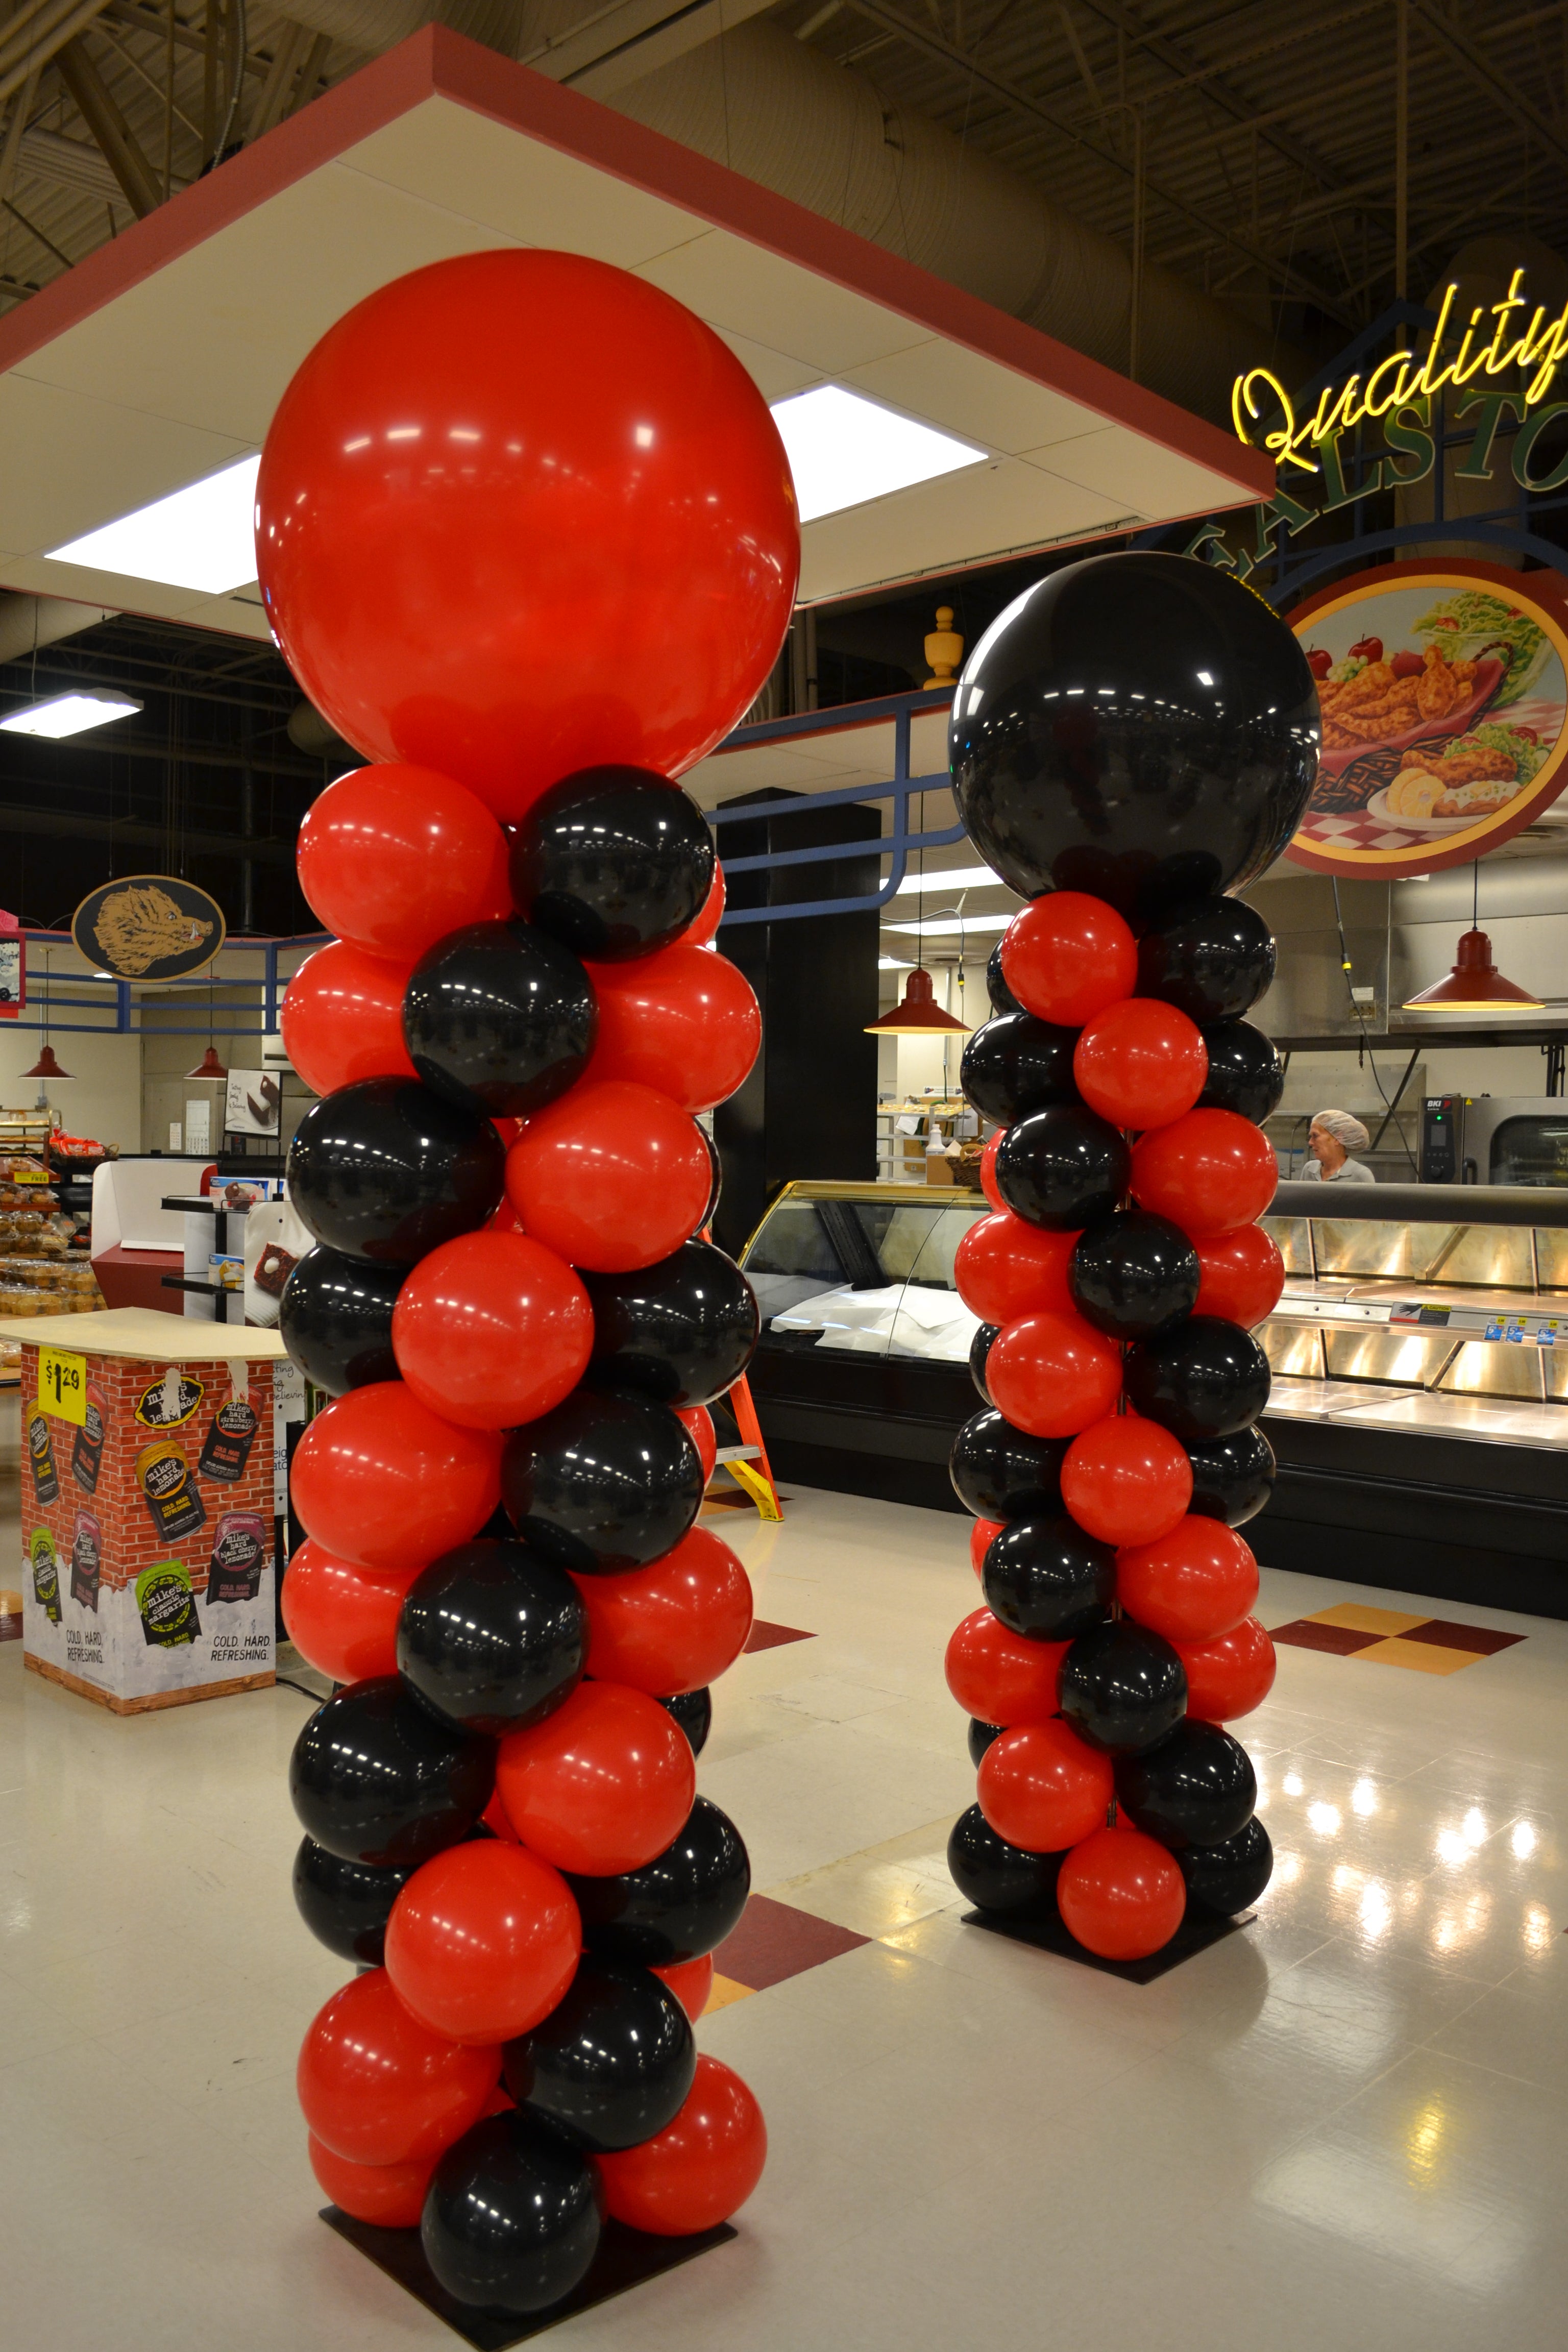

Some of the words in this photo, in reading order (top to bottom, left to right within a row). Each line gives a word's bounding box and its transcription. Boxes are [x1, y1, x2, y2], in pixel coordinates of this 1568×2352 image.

[1231, 268, 1568, 473] Quality
[146, 1459, 177, 1483] mike's
[156, 1466, 179, 1486] hard
[152, 1467, 185, 1497] lemonade
[226, 1533, 250, 1544] mike's
[230, 1540, 247, 1550] hard
[220, 1550, 237, 1558] black
[238, 1544, 257, 1554] cherry
[146, 1585, 182, 1608] mike's
[152, 1594, 180, 1615] classic
[148, 1596, 190, 1625] margarita
[66, 1629, 83, 1644] COLD.
[213, 1635, 239, 1647] COLD.
[244, 1635, 271, 1647] HARD.
[67, 1647, 105, 1664] REFRESHING.
[210, 1649, 269, 1661] REFRESHING.
